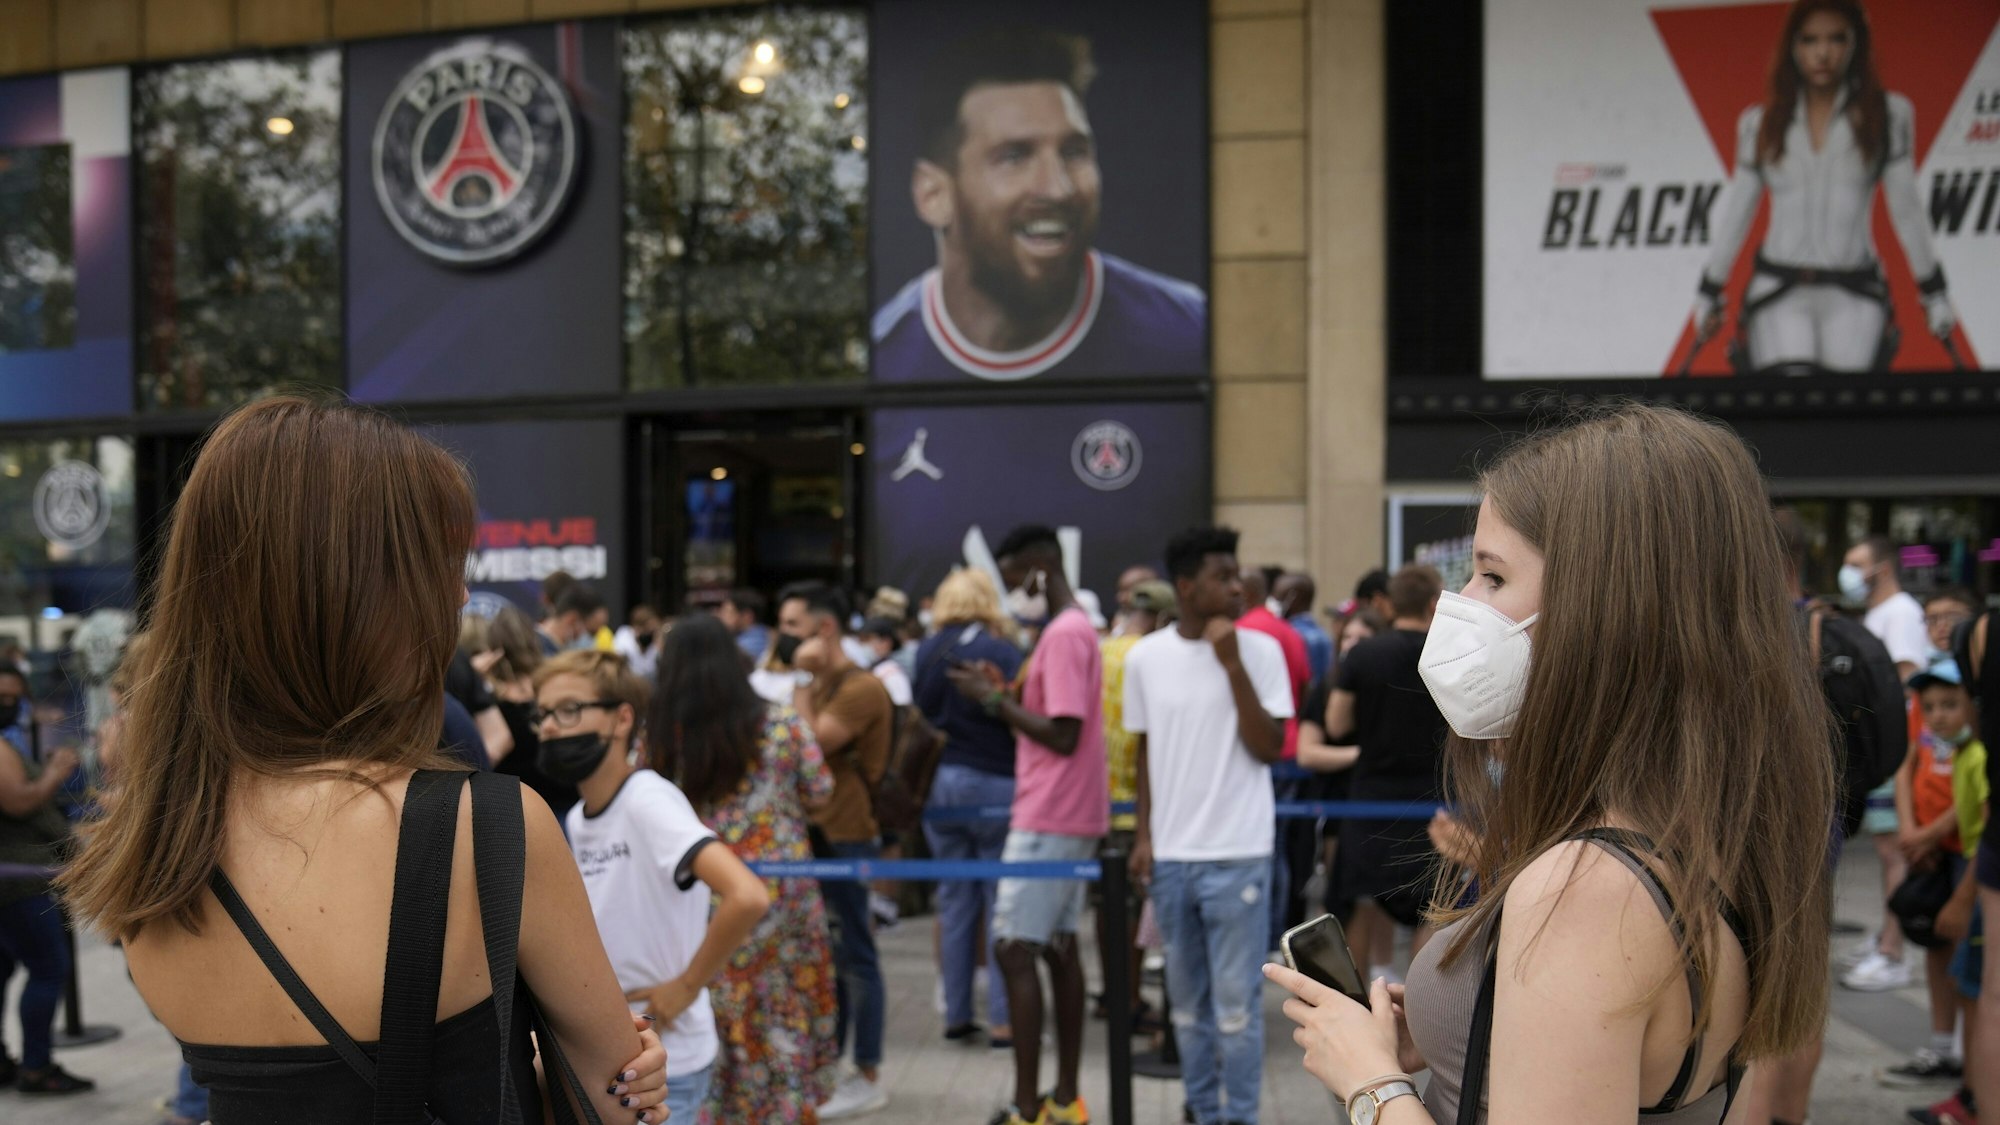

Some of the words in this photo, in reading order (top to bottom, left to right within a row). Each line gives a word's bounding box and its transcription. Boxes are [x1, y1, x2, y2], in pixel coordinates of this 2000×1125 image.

[405, 57, 540, 113] PARIS
[1542, 183, 1722, 250] BLACK
[1929, 168, 2000, 235] WI
[464, 547, 606, 582] MESSI
